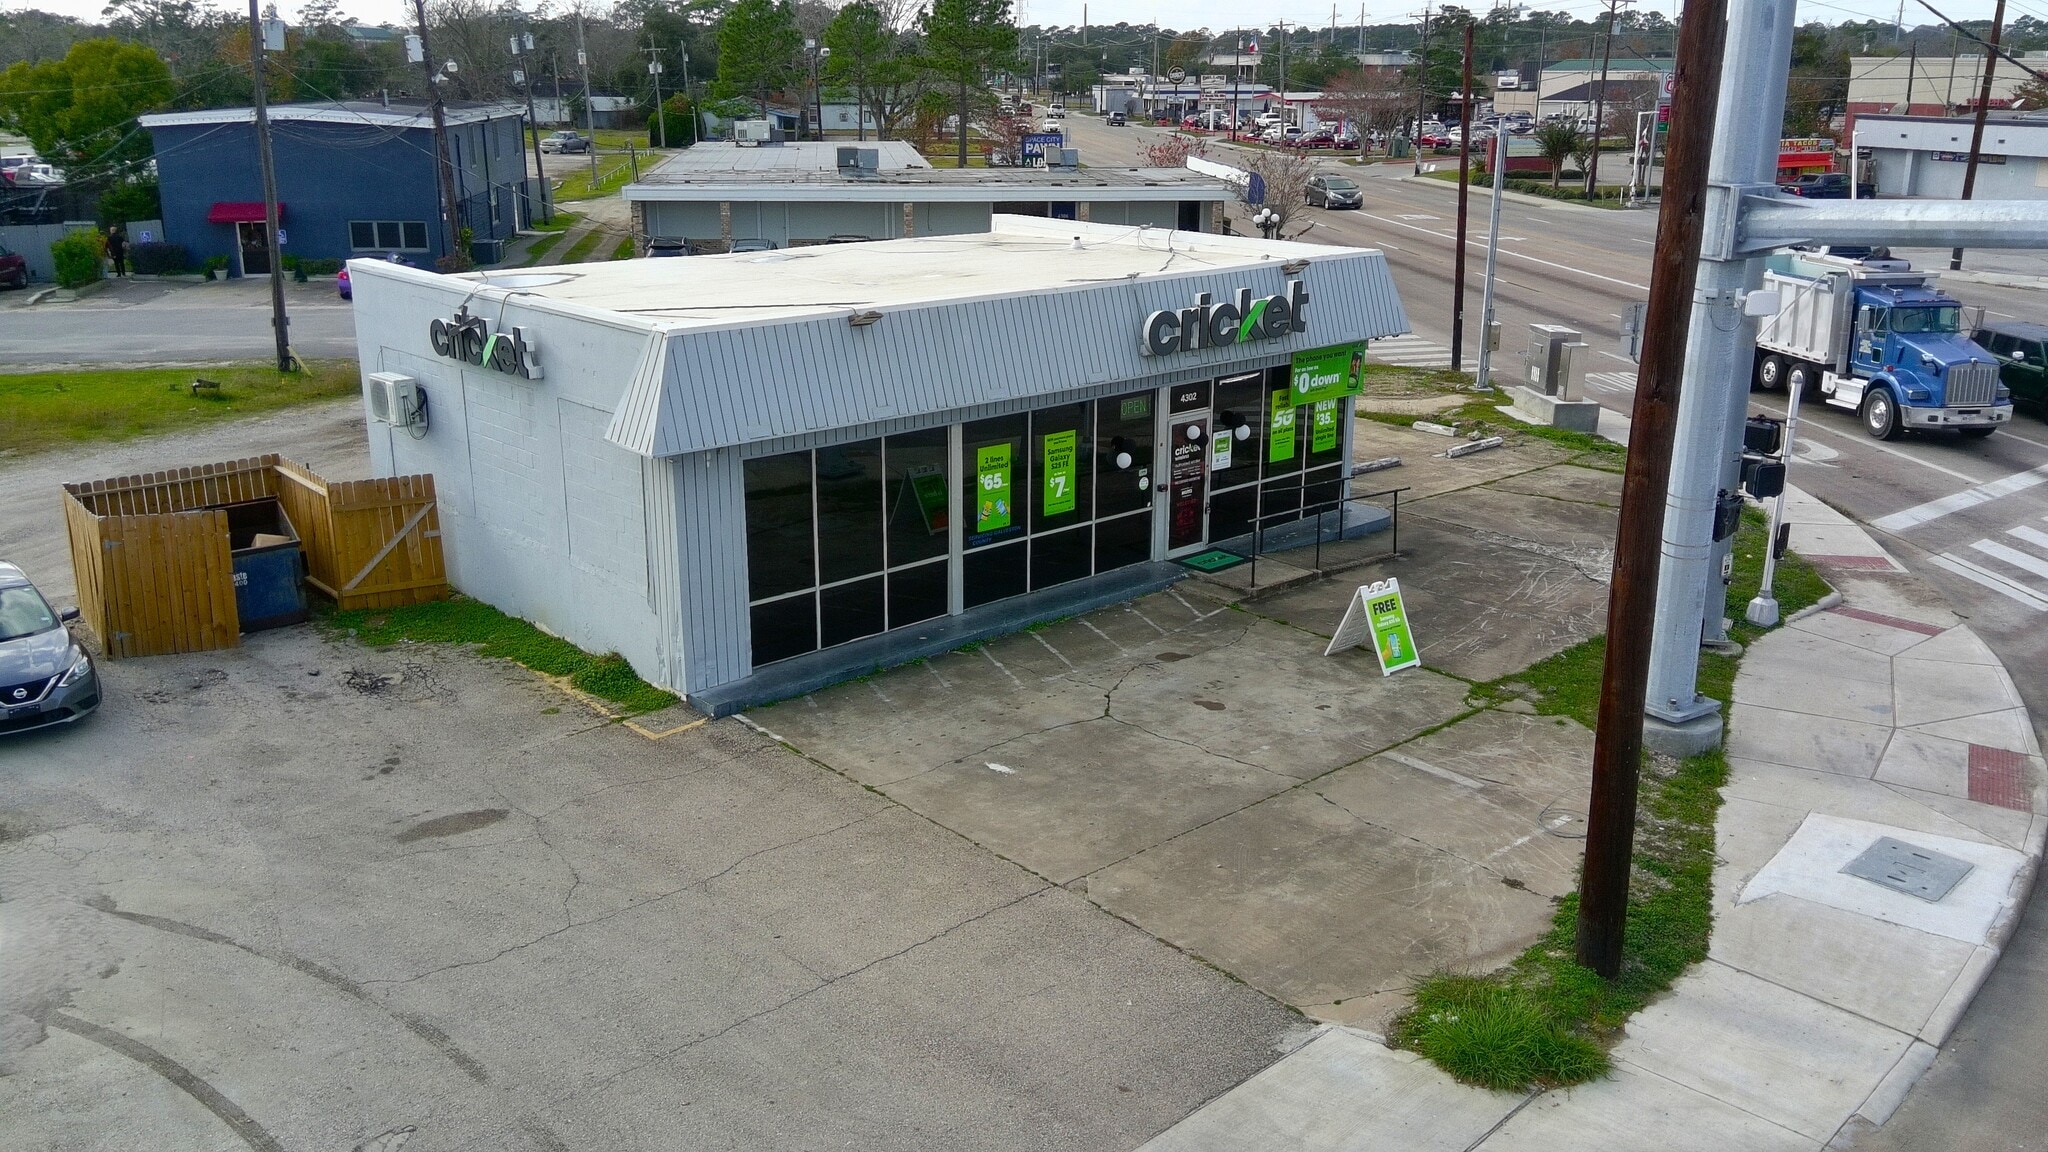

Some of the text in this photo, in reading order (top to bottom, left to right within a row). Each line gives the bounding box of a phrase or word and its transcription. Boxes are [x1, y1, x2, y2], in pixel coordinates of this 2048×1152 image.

[1143, 279, 1310, 357] cricket
[430, 313, 543, 380] cricket
[1305, 354, 1322, 364] phone
[1323, 353, 1333, 361] you
[1333, 350, 1347, 358] want
[1293, 372, 1310, 394] $0
[1180, 392, 1197, 403] 4302
[1121, 399, 1147, 416] OPEN
[1316, 398, 1336, 412] NEW
[1272, 408, 1295, 428] 5G
[1316, 412, 1331, 426] $35
[1047, 445, 1073, 455] Samsung
[1049, 454, 1071, 462] Galaxy
[980, 461, 1008, 472] Unlimited
[1372, 598, 1397, 616] FREE
